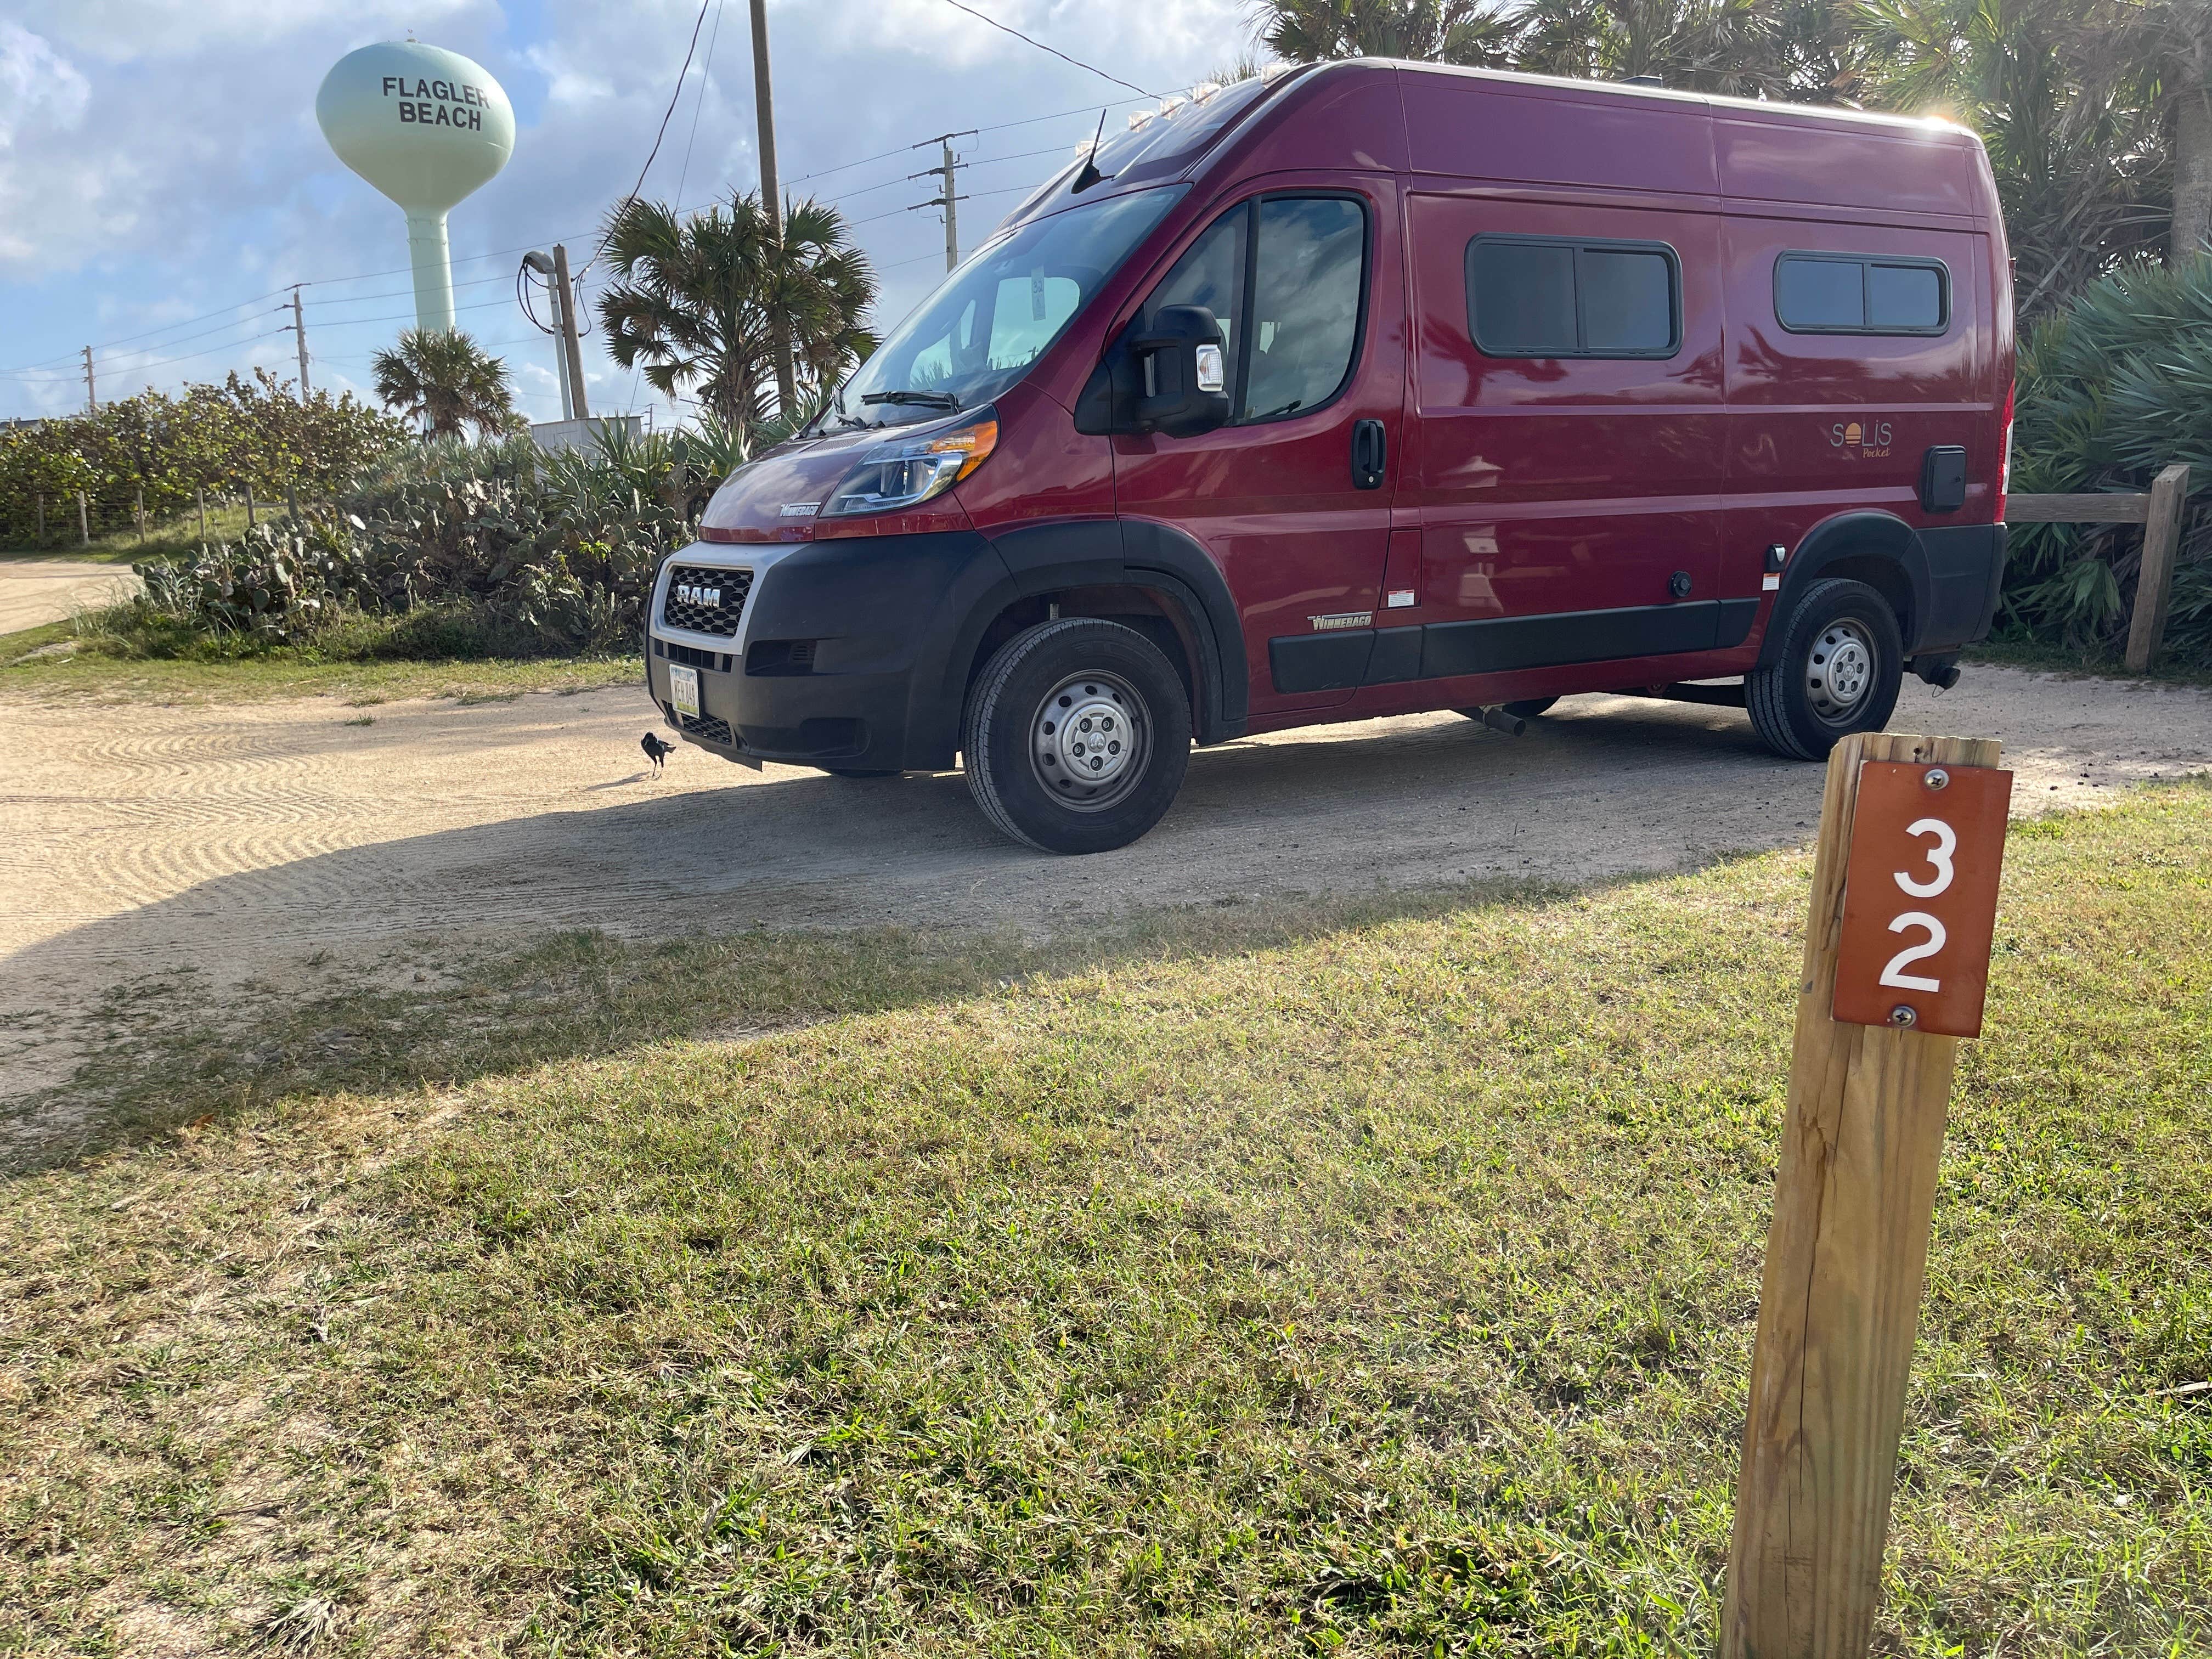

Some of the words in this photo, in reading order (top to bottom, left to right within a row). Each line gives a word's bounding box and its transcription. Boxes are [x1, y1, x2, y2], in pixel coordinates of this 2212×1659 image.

[382, 77, 490, 109] FLAGLER
[399, 102, 481, 131] BEACH
[1863, 448, 1891, 458] Pocket
[676, 585, 720, 607] RAM
